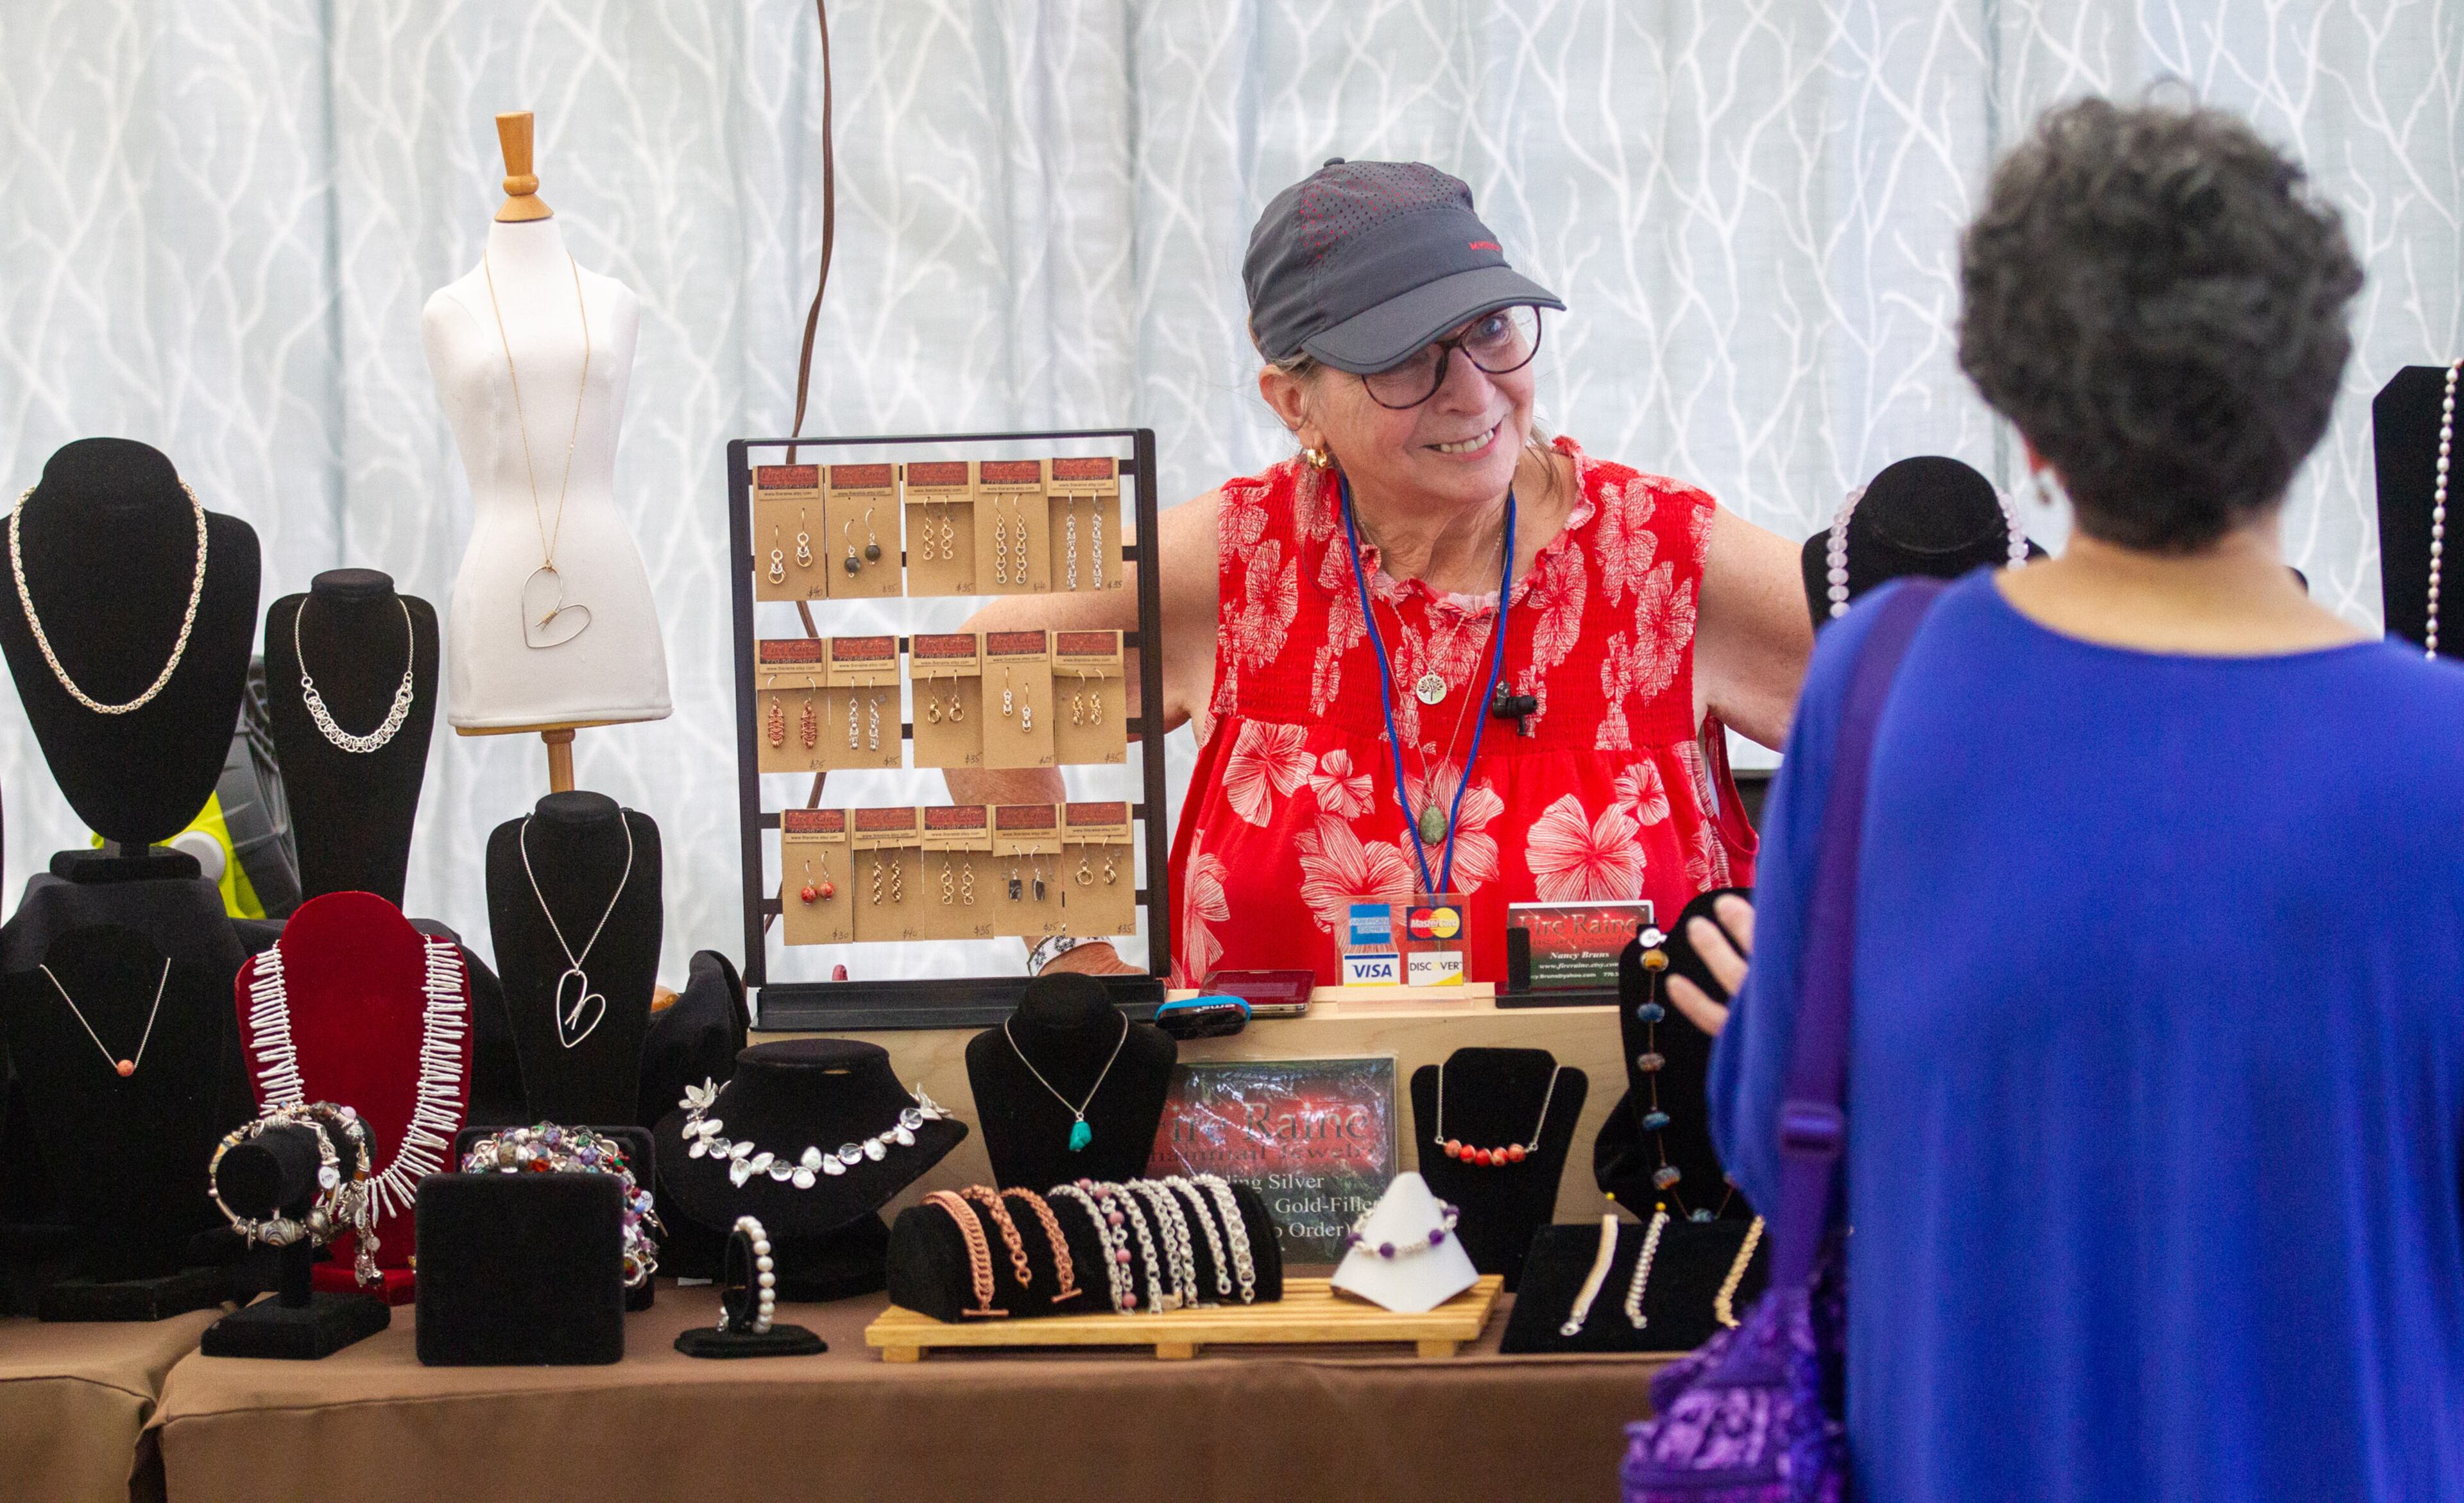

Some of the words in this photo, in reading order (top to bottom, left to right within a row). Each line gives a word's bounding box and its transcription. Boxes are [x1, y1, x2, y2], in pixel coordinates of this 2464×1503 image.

[1550, 952, 1580, 960] Nancy
[1352, 964, 1392, 978] VISA
[1410, 962, 1459, 971] DISCVER
[1242, 1102, 1369, 1140] Raine
[1269, 1174, 1325, 1189] Silver
[1275, 1196, 1382, 1213] Gold-Fille
[1289, 1221, 1351, 1238] Order)
